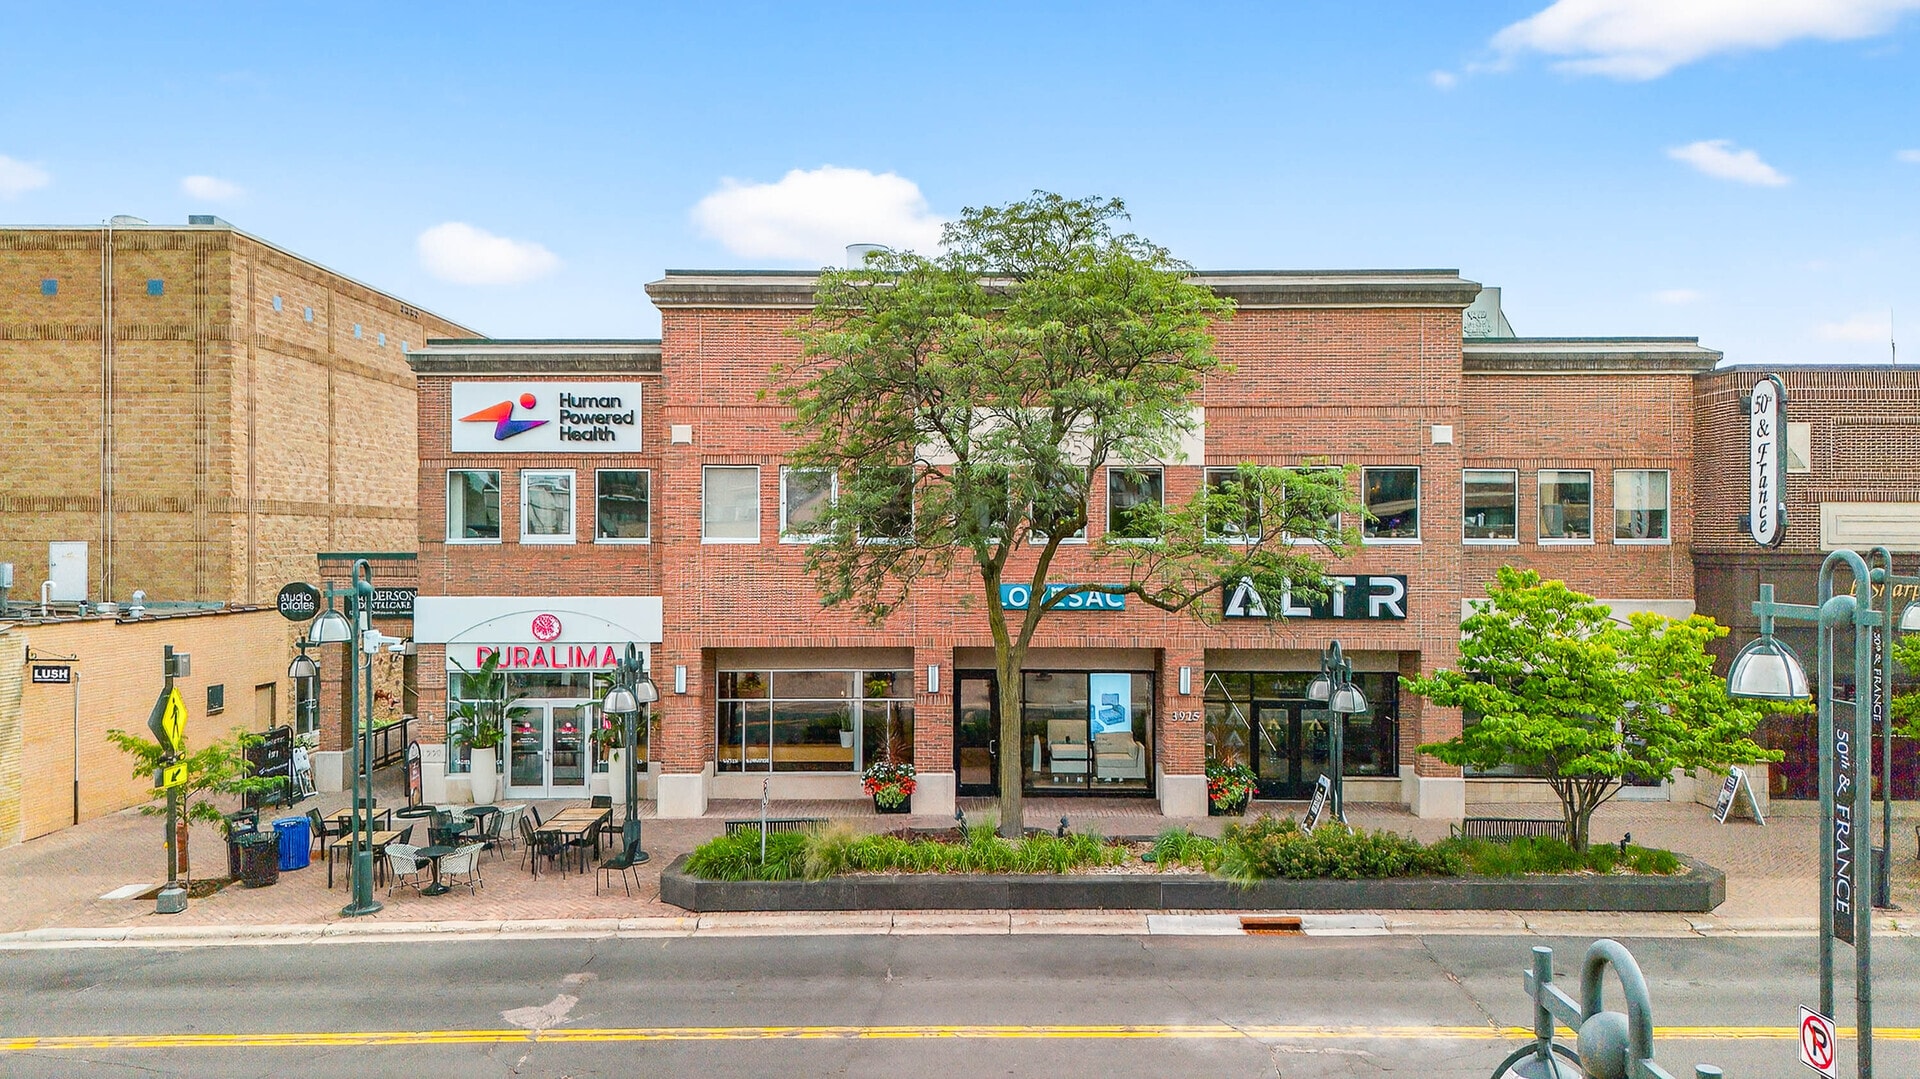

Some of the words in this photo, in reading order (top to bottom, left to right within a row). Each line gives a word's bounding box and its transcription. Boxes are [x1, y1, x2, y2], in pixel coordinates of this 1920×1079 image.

[559, 392, 622, 409] Human
[559, 409, 635, 426] Powered
[1756, 418, 1770, 438] &
[559, 425, 616, 441] Health
[1756, 442, 1770, 533] France
[476, 645, 618, 669] PURALIMA
[34, 669, 69, 679] LUSH
[1873, 668, 1882, 721] FRANCE
[1836, 773, 1850, 796] &
[1836, 803, 1851, 915] FRANCE
